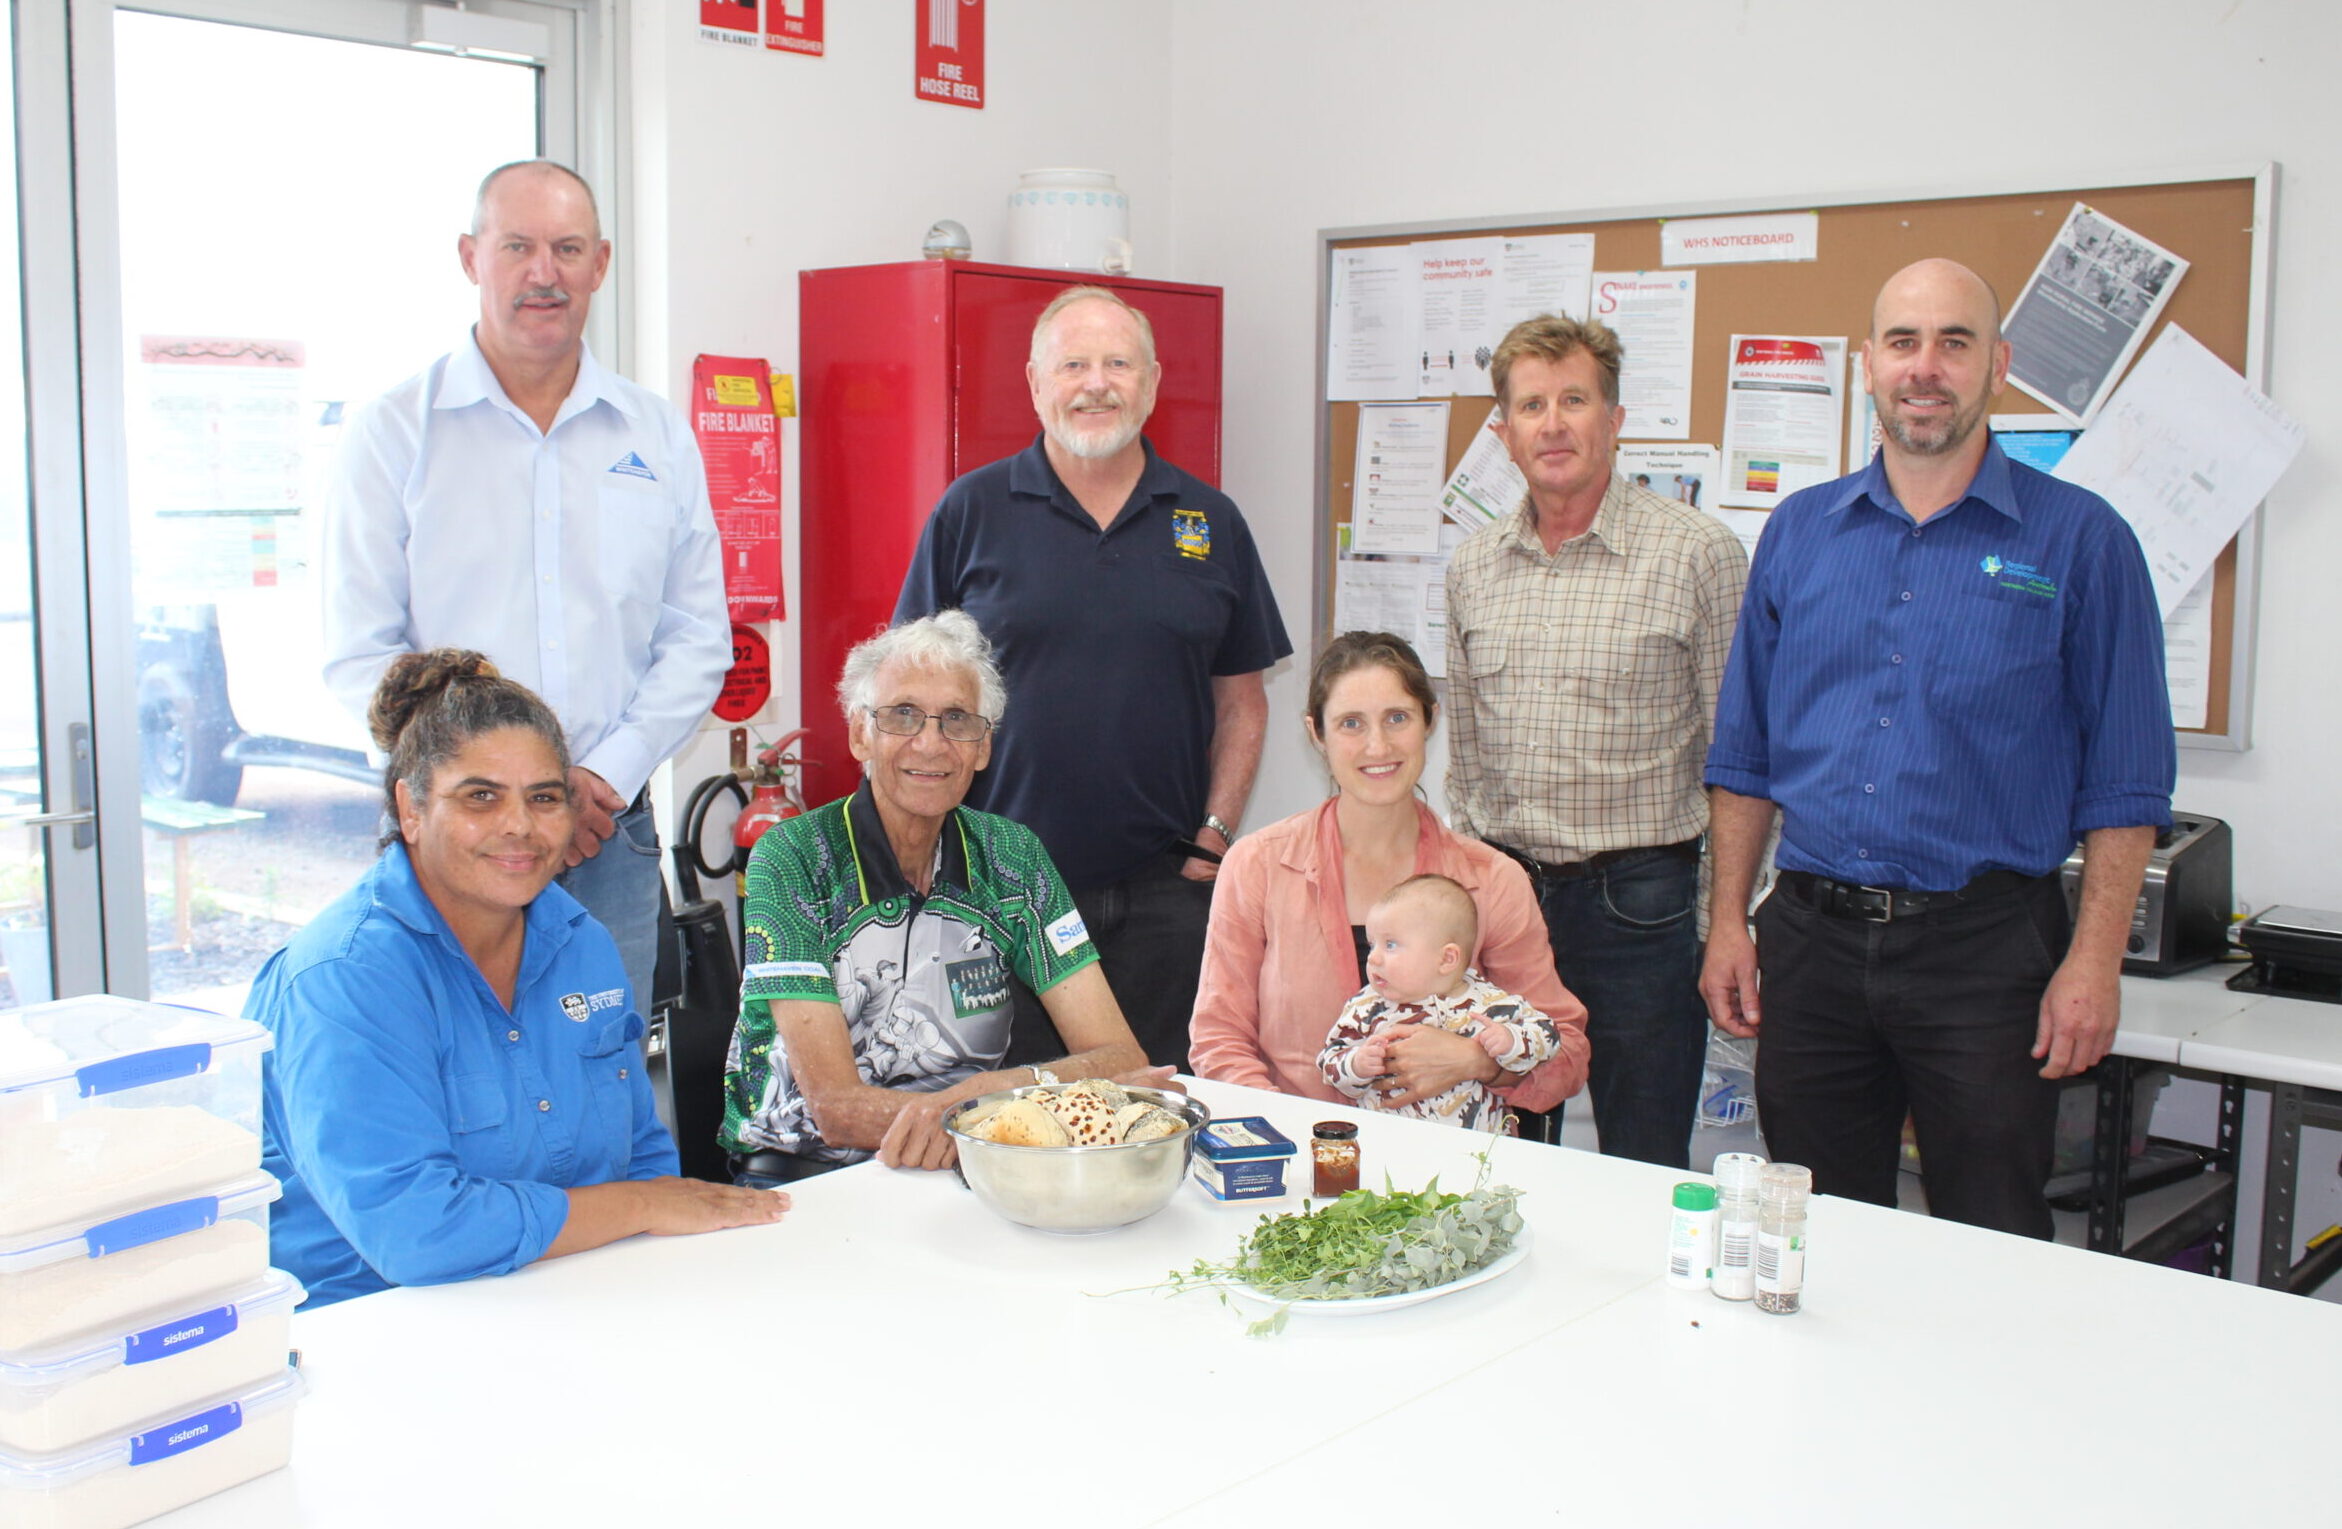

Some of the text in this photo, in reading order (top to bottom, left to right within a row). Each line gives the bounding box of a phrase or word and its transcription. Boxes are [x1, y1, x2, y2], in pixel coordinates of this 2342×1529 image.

[784, 20, 804, 34] FIRE
[700, 29, 758, 47] FIRE BLANKET
[765, 33, 824, 53] EXTINGUISHER
[937, 62, 963, 81] FIRE
[920, 77, 980, 102] HOSE REEL
[1683, 232, 1795, 249] WHS NOTICEBOARD
[1423, 257, 1486, 270] Help keep our
[1422, 267, 1493, 281] community safe
[698, 411, 775, 433] FIRE BLANKET
[121, 1062, 173, 1081] sistema
[163, 1326, 205, 1346] sistema
[168, 1424, 209, 1446] sistema
